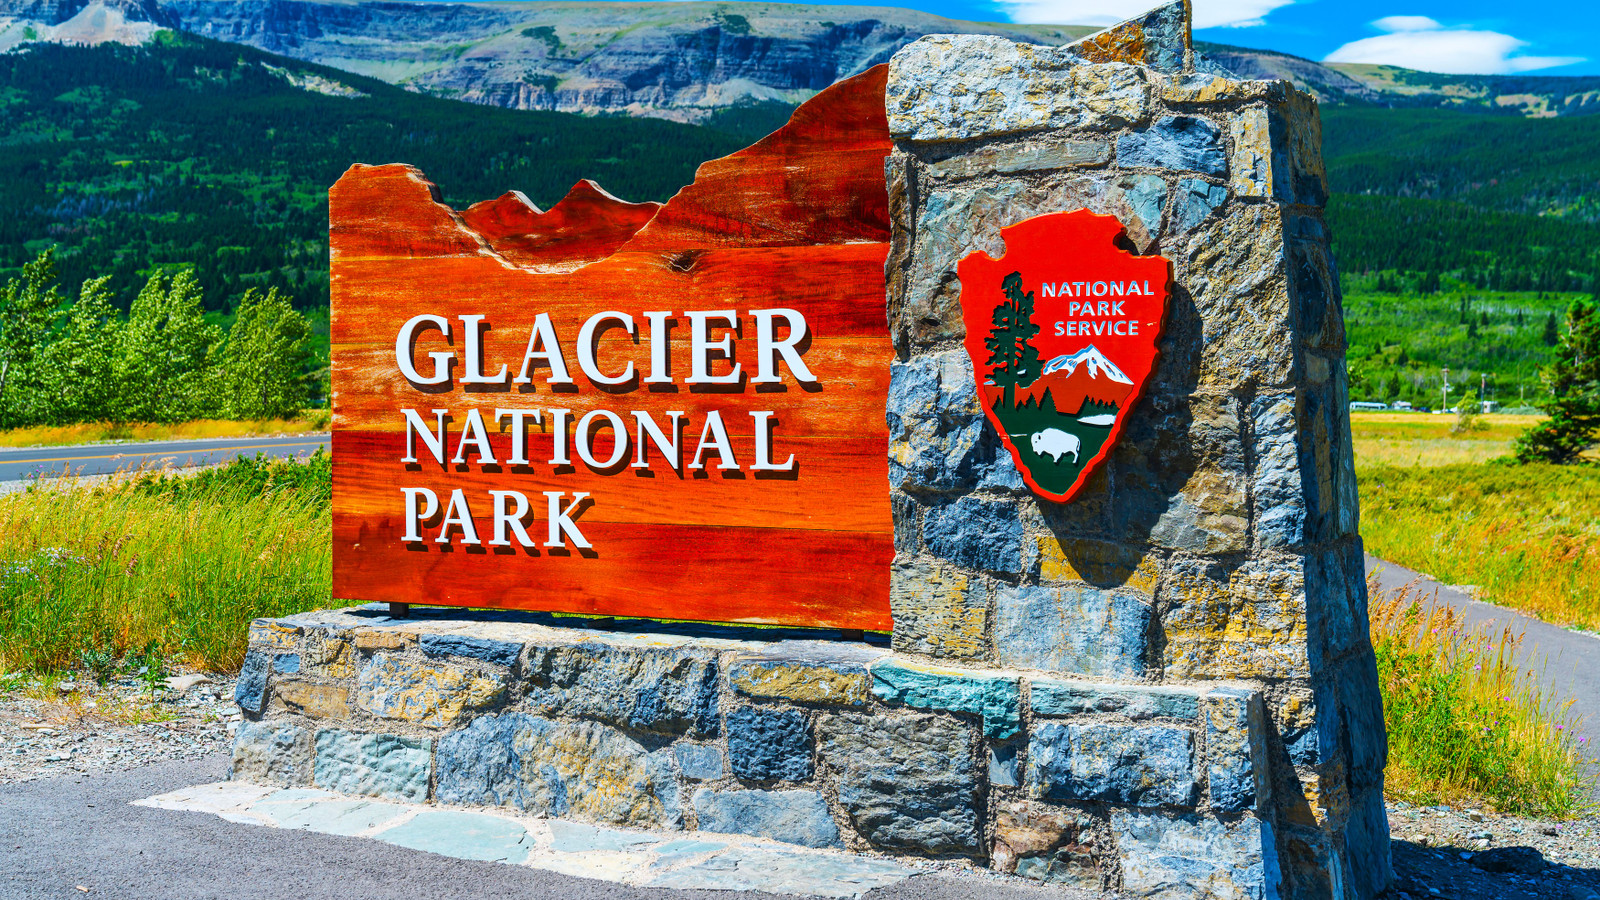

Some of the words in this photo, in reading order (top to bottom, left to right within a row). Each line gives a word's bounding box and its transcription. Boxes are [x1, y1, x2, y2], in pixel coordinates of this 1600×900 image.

[1041, 280, 1155, 297] NATIONAL
[1068, 300, 1126, 316] PARK
[395, 308, 818, 385] GLACIER
[1054, 320, 1139, 336] SERVICE
[400, 407, 796, 471] NATIONAL
[400, 487, 593, 549] PARK
